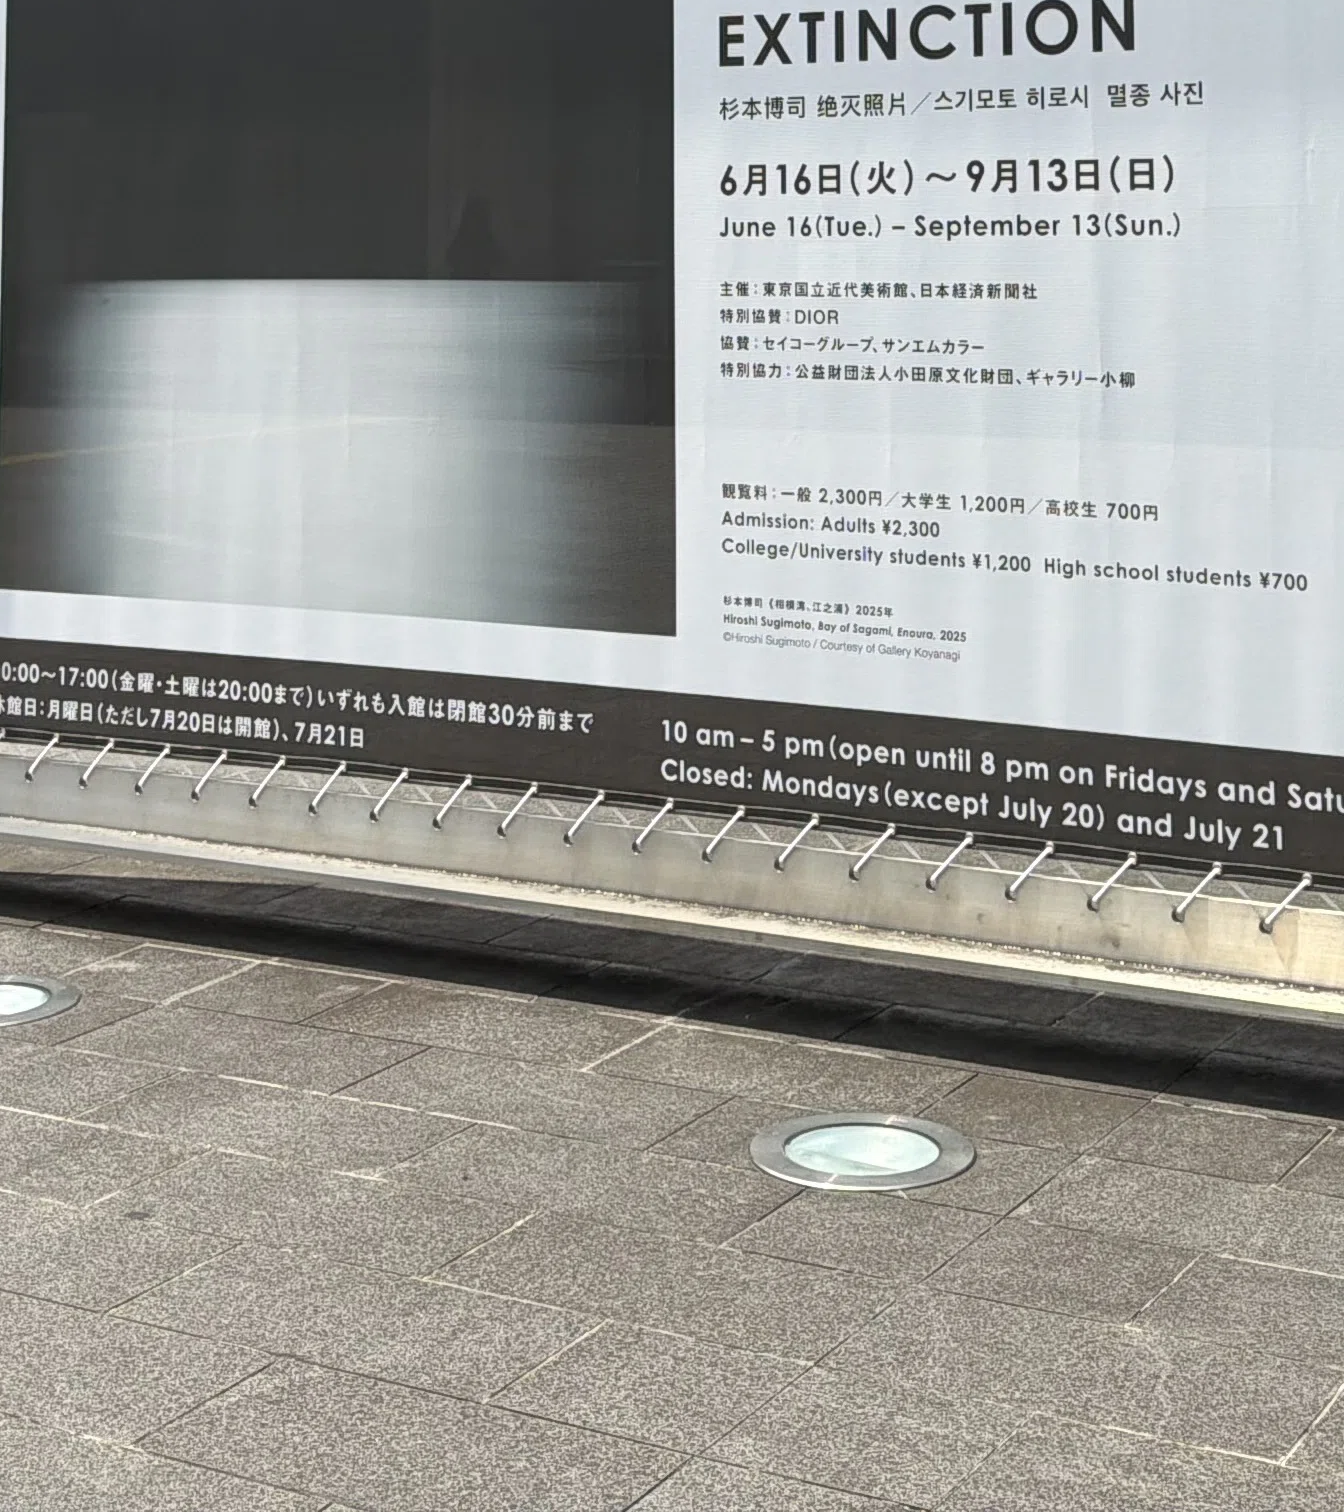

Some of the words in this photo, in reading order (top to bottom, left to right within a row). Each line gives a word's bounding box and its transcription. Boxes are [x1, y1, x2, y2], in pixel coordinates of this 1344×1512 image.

[719, 95, 806, 121] 杉本博司
[1025, 84, 1089, 111] 히로시
[1107, 83, 1151, 108] 멸종
[1159, 80, 1204, 107] 사진
[719, 216, 777, 238] June
[914, 213, 1061, 242] September
[721, 510, 815, 531] Admission:
[820, 515, 876, 535] Adults
[881, 519, 940, 538] ¥2,300
[1105, 502, 1159, 522] 700円
[721, 537, 884, 567] College/University
[889, 548, 966, 569] students
[972, 553, 1032, 573] ¥1,200
[1044, 557, 1087, 580] High
[1093, 561, 1159, 582] school
[1166, 565, 1252, 588] students
[1259, 571, 1308, 592] ¥700
[723, 613, 758, 626] Hiroshi
[760, 615, 815, 632] Sugimoto,
[817, 620, 838, 634] Bay
[839, 622, 851, 633] of
[852, 622, 894, 638] Sagami,
[896, 626, 936, 641] Enoura,
[939, 629, 967, 643] 2025
[765, 634, 812, 649] Sugimoto
[819, 638, 864, 655] Courtesy
[865, 643, 876, 654] of
[877, 643, 912, 660] Gallery
[913, 646, 961, 663] Koyanagi
[661, 719, 688, 744] 10
[695, 727, 735, 749] am
[761, 729, 776, 752] 5
[915, 747, 971, 773] until
[980, 751, 996, 776] 8
[1005, 759, 1049, 783] pm
[1059, 765, 1094, 786] on
[1105, 763, 1207, 802] Fridays
[1217, 780, 1276, 806] and
[660, 758, 753, 790] Closed:
[998, 794, 1053, 829] July
[1061, 801, 1105, 831] 20)
[1116, 812, 1173, 838] and
[1183, 815, 1242, 851] July
[1252, 823, 1283, 851] 21
